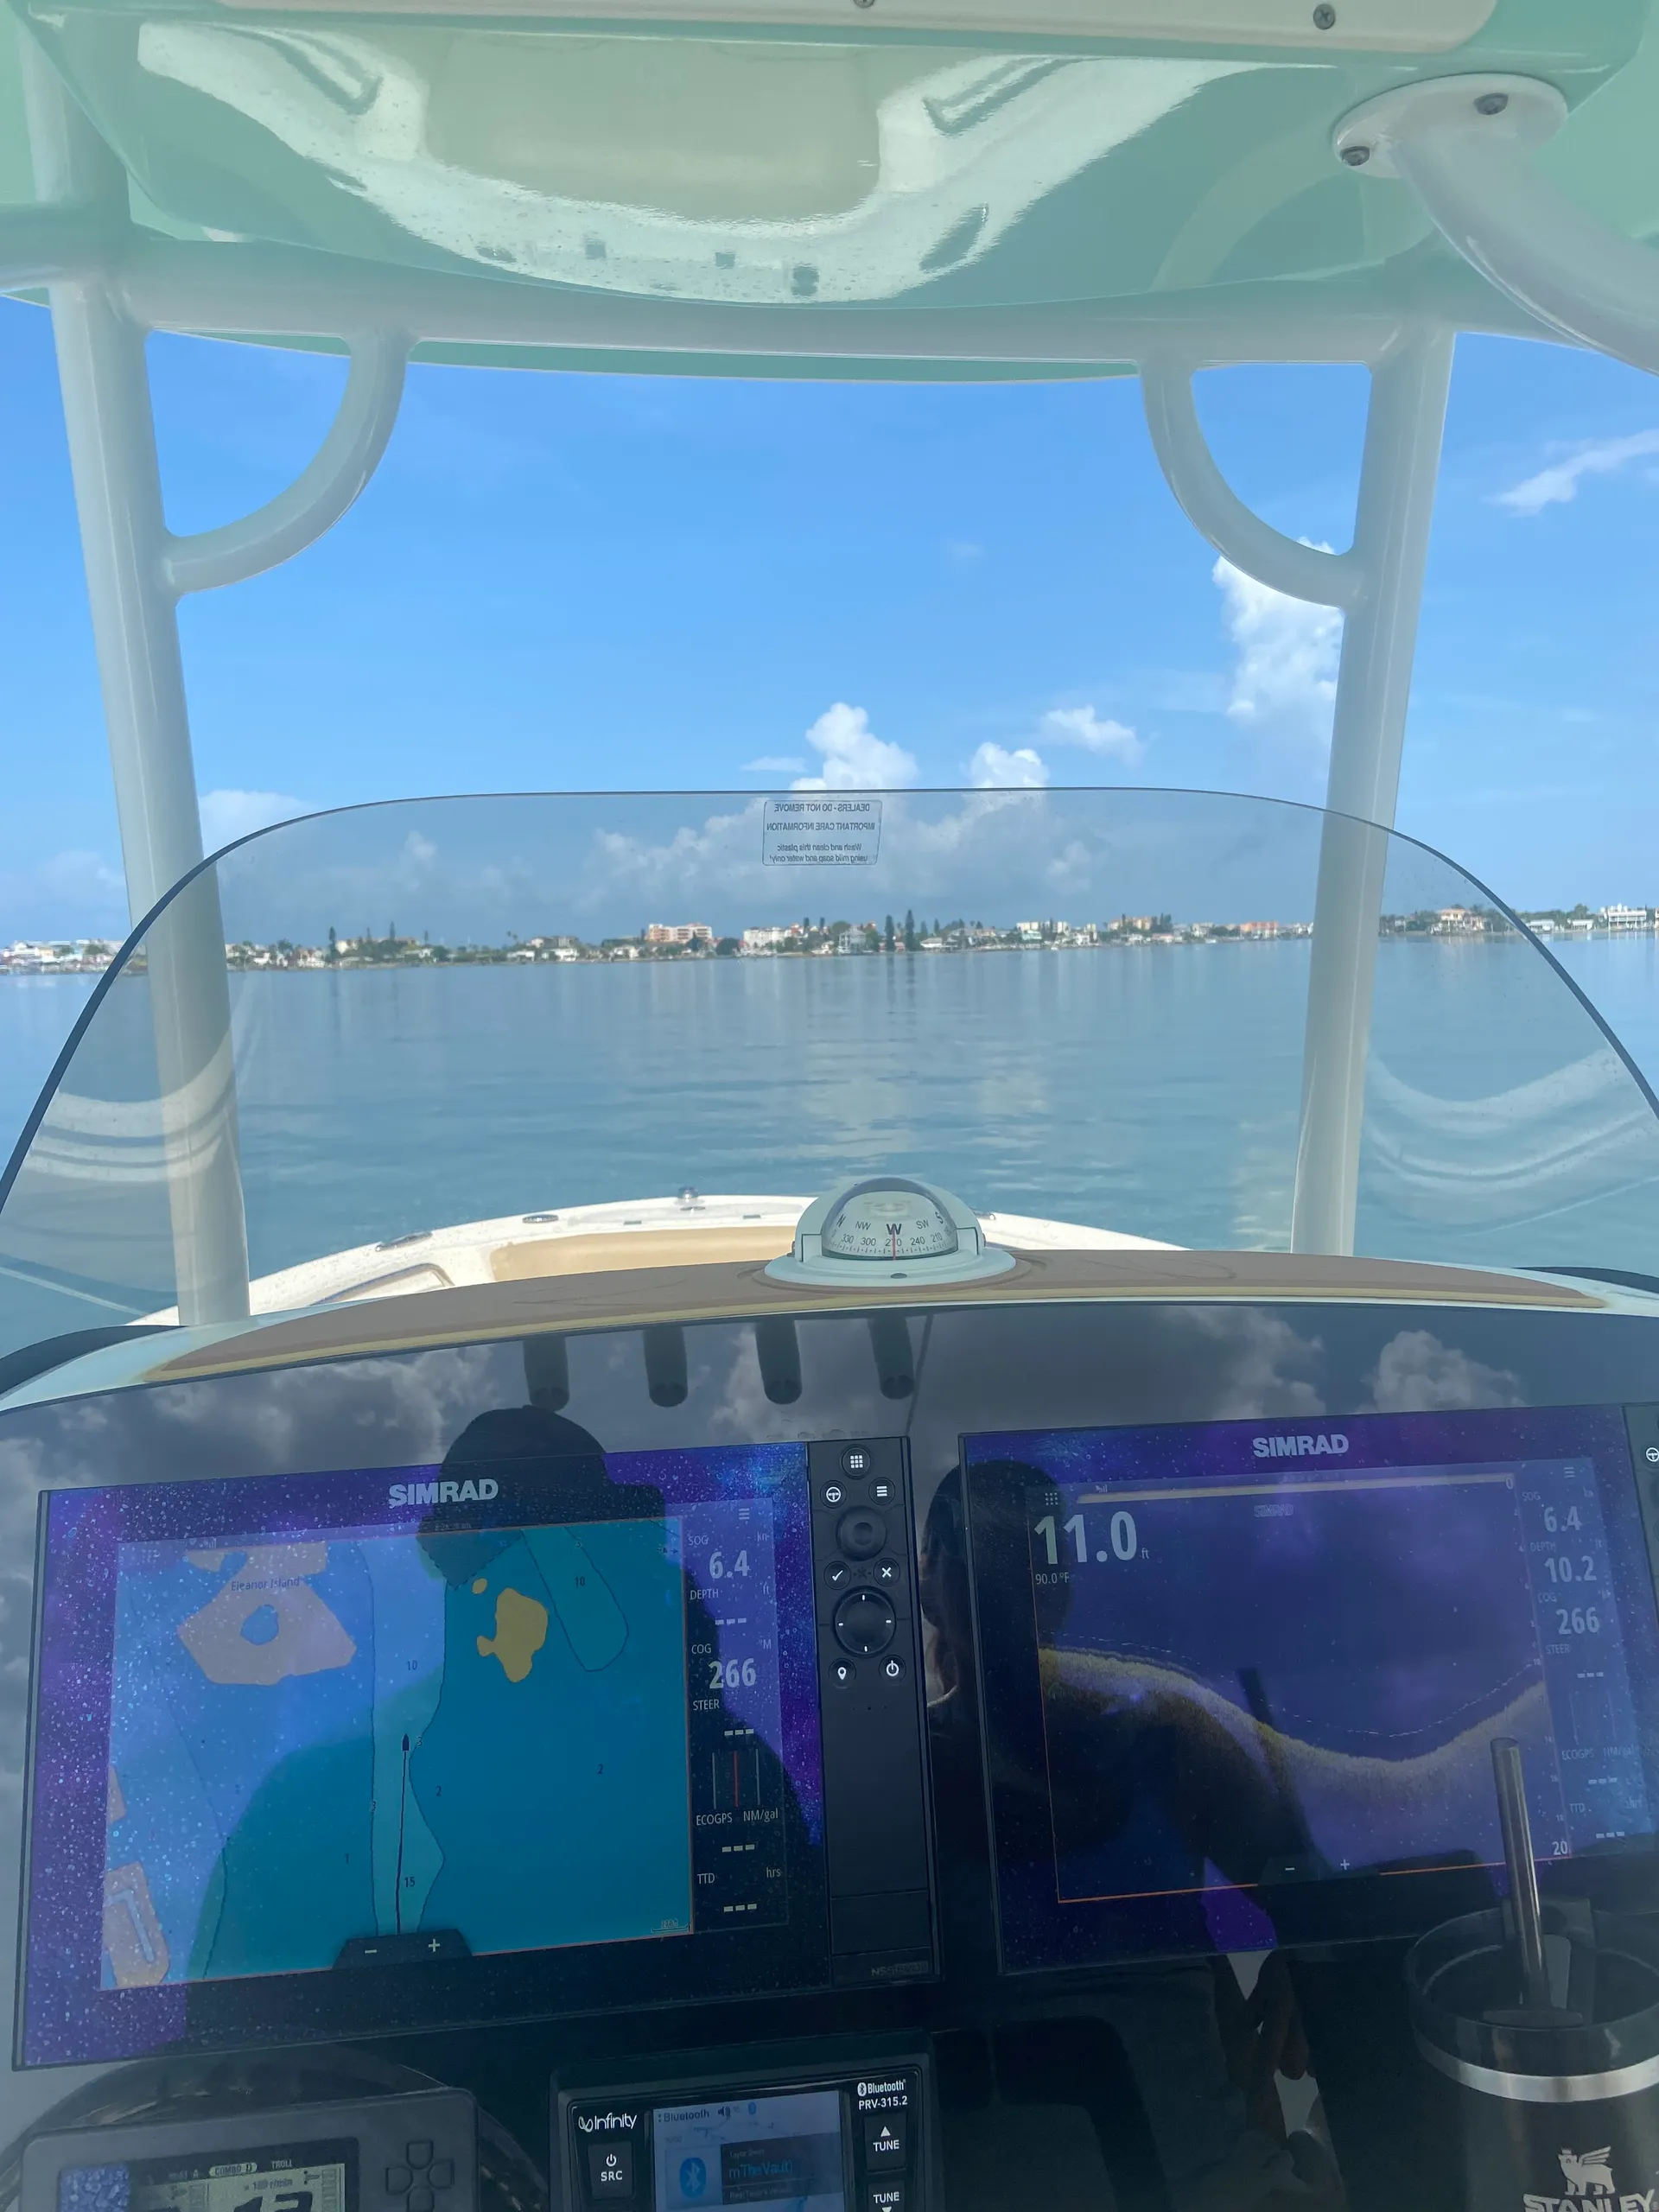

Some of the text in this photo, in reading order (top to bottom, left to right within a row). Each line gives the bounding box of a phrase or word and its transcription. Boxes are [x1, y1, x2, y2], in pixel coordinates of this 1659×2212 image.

[836, 1211, 944, 1235] N NW W SW S
[841, 1233, 855, 1244] 330
[861, 1237, 877, 1247] 300
[910, 1236, 925, 1246] 240
[931, 1232, 943, 1243] 210
[1251, 1433, 1350, 1459] SIMRAD
[388, 1478, 499, 1508] SIMRAD
[1521, 1491, 1541, 1502] SOG
[1543, 1505, 1582, 1533] 6.4
[688, 1535, 709, 1546] SOG
[1033, 1510, 1137, 1565] 11.0
[1529, 1541, 1557, 1553] DEPTH
[709, 1550, 750, 1580] 6.4
[1544, 1555, 1598, 1583] 10.2
[232, 1576, 301, 1592] Eleanor Island
[575, 1576, 585, 1588] 10
[1034, 1573, 1058, 1585] 90.0
[690, 1588, 719, 1600] DEPTH
[1537, 1592, 1557, 1604] COG
[1555, 1607, 1600, 1635] 266
[691, 1643, 712, 1655] COG
[1545, 1643, 1571, 1656] STEER
[407, 1661, 418, 1671] 10
[709, 1657, 757, 1689] 266
[692, 1699, 720, 1711] STEER
[416, 1737, 423, 1747] 3
[1560, 1748, 1595, 1760] ECOGPS
[597, 1763, 604, 1775] 2
[435, 1786, 442, 1797] 2
[696, 1807, 779, 1826] ECOGPS NM/gal
[1552, 1840, 1568, 1855] 20
[404, 1877, 416, 1887] 15
[696, 1866, 781, 1885] TTD hrs
[858, 2095, 908, 2111] PRV-315.2
[664, 2108, 709, 2123] Bluetooth
[873, 2139, 900, 2152] TUNE
[601, 2170, 623, 2182] SRC
[873, 2190, 900, 2204] TUNE
